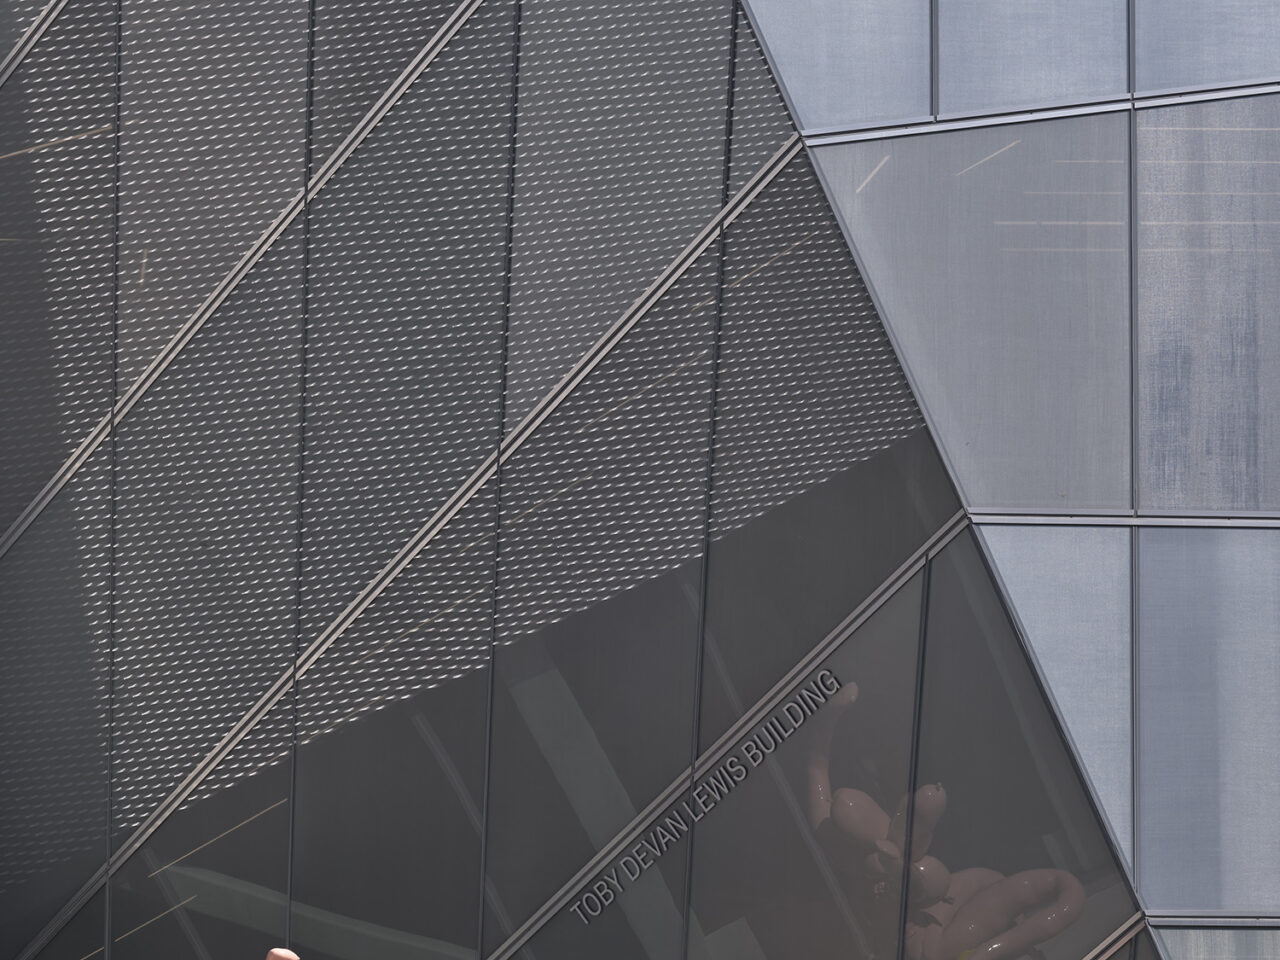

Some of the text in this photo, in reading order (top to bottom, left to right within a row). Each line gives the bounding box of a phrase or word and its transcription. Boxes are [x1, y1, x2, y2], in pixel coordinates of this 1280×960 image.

[570, 668, 842, 925] TOBY DEVAN LEWIS BUILDING
